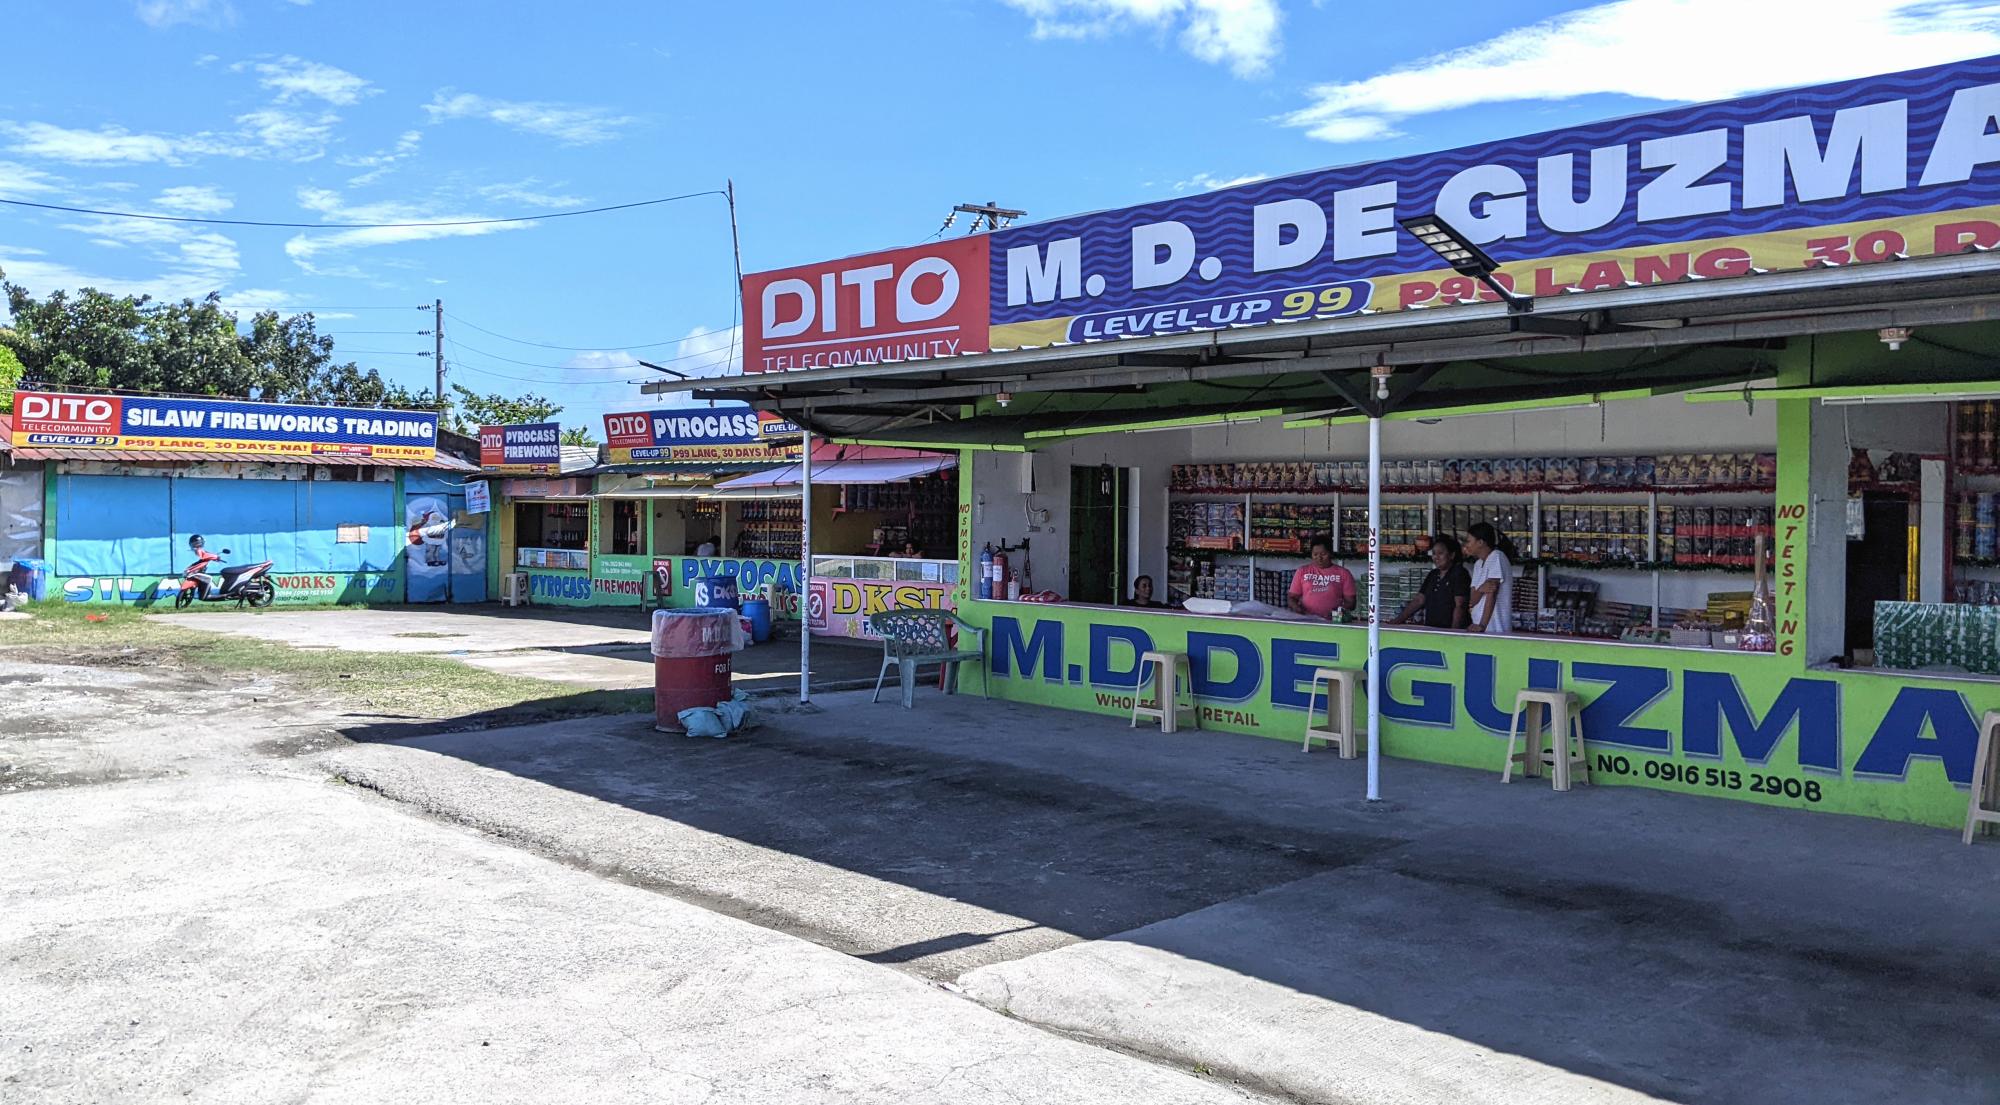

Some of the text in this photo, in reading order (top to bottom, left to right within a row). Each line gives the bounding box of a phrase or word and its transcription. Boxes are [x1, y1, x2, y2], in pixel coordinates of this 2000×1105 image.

[1007, 237, 1105, 307] M.
[1132, 221, 1222, 291] D.
[1254, 180, 1397, 272] DE
[1400, 272, 1515, 309] P99
[1804, 229, 1907, 269] 30
[762, 257, 960, 339] DITO
[1084, 287, 1352, 336] LEVEL-UP 99
[22, 396, 113, 421] DITO
[22, 423, 112, 433] TELECOMMUNITY
[127, 408, 433, 438] SILAW FIREWORKS TRADING
[608, 414, 759, 439] DITO PYROCASS
[33, 435, 114, 445] LEVEL-UP 99
[125, 439, 307, 452] P99 LANG, 30 DAYS NA!
[481, 429, 556, 448] DITO PYROCASS
[403, 448, 426, 456] NA!
[504, 444, 559, 458] FIREWORKS
[632, 448, 670, 458] LEVEL-UP 99
[673, 449, 690, 459] P99
[722, 448, 734, 458] 30
[735, 447, 762, 458] DAYS
[1369, 527, 1376, 548] NO
[344, 575, 397, 592] Trading
[530, 574, 592, 600] PYROCASS
[1303, 573, 1341, 583] STRANGE
[1778, 503, 1805, 656] NO TESTING
[1187, 631, 1339, 713] DE
[1203, 707, 1260, 727] RETAIL
[1598, 754, 1638, 777] NO.
[1645, 760, 1699, 785] 0916
[1705, 767, 1742, 790] 513
[1750, 773, 1823, 802] 2908
